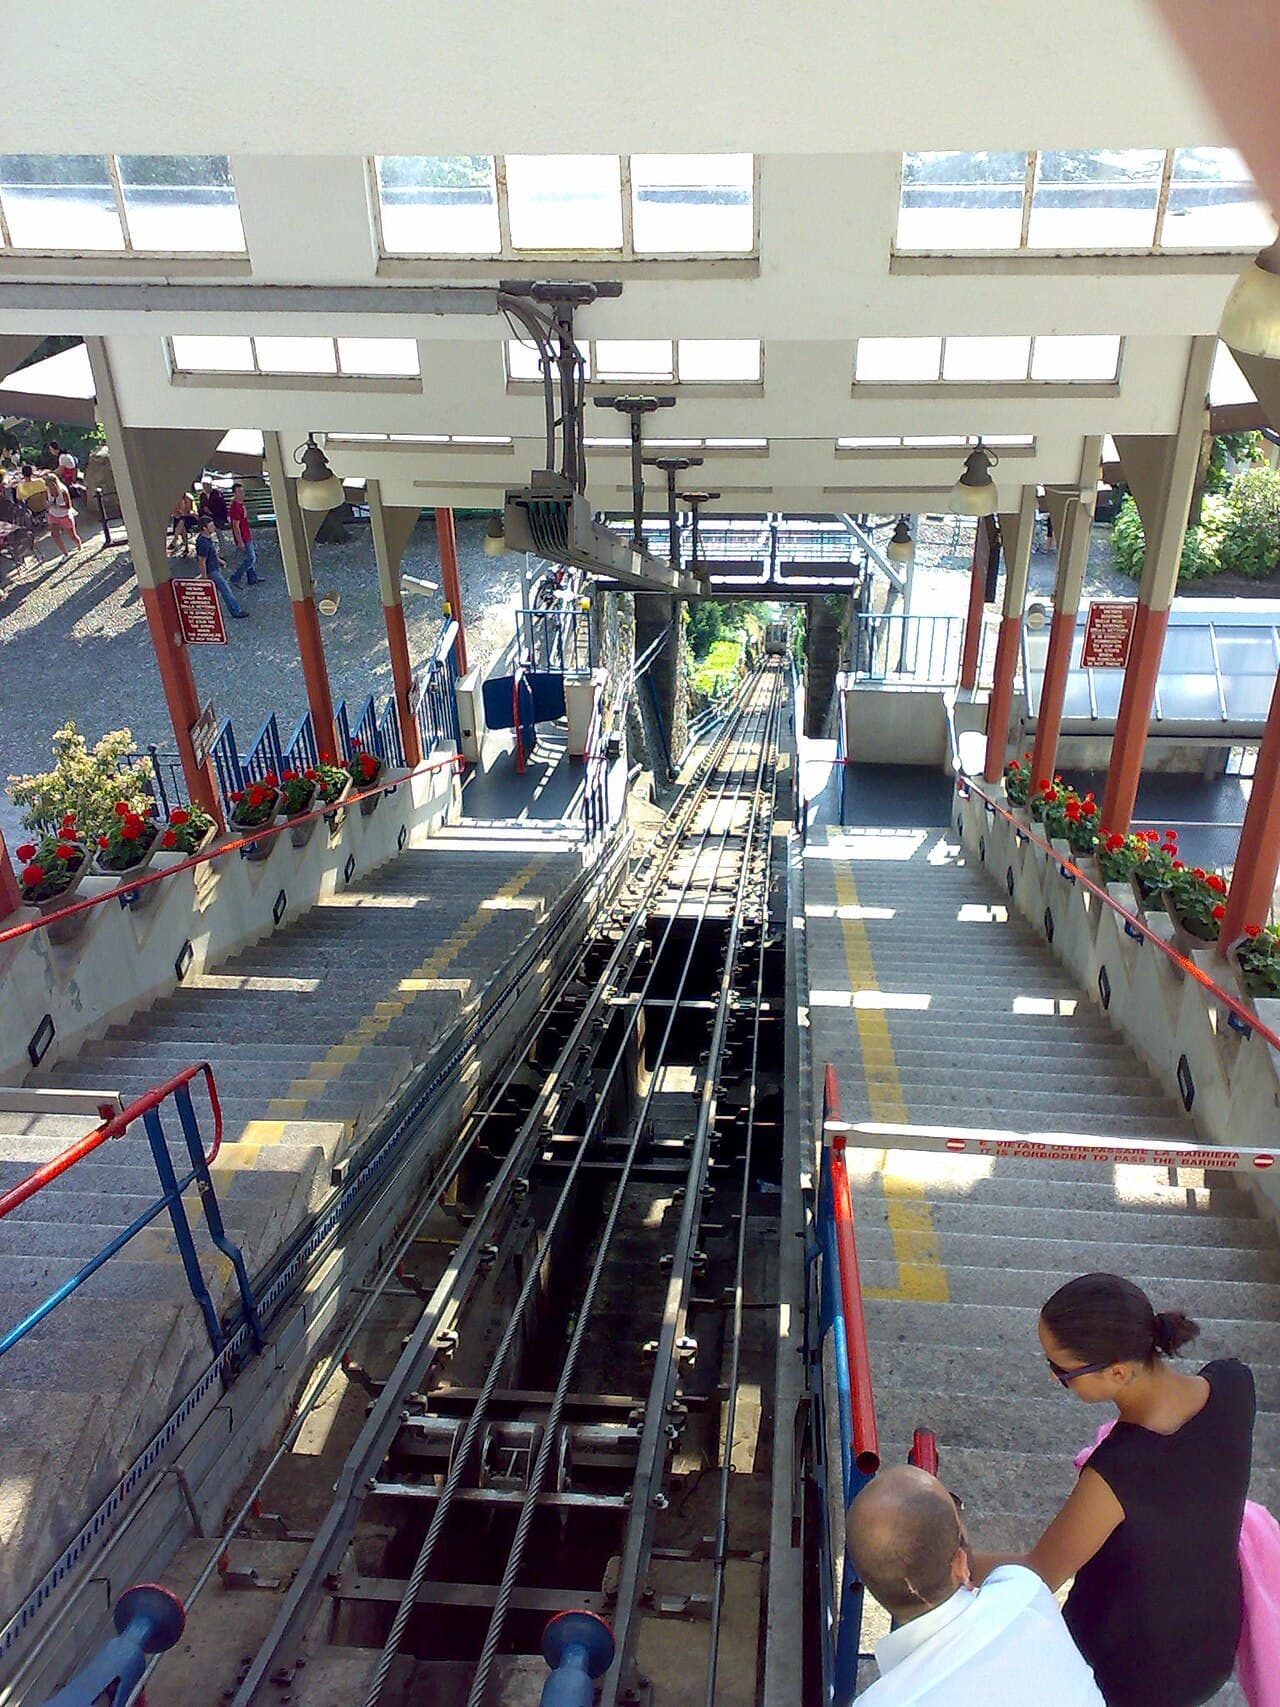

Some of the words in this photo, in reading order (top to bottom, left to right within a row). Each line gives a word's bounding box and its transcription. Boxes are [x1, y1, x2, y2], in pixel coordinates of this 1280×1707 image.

[997, 1141, 1046, 1150] VIETATO
[1051, 1145, 1148, 1155] OLTREPASSARE
[1176, 1151, 1240, 1159] BARRIERA
[1014, 1150, 1087, 1161] FORBIDDEN
[1093, 1154, 1109, 1162] TO
[1114, 1155, 1146, 1163] PASS
[1152, 1157, 1176, 1165] THE
[1181, 1159, 1238, 1167] BARRIER
